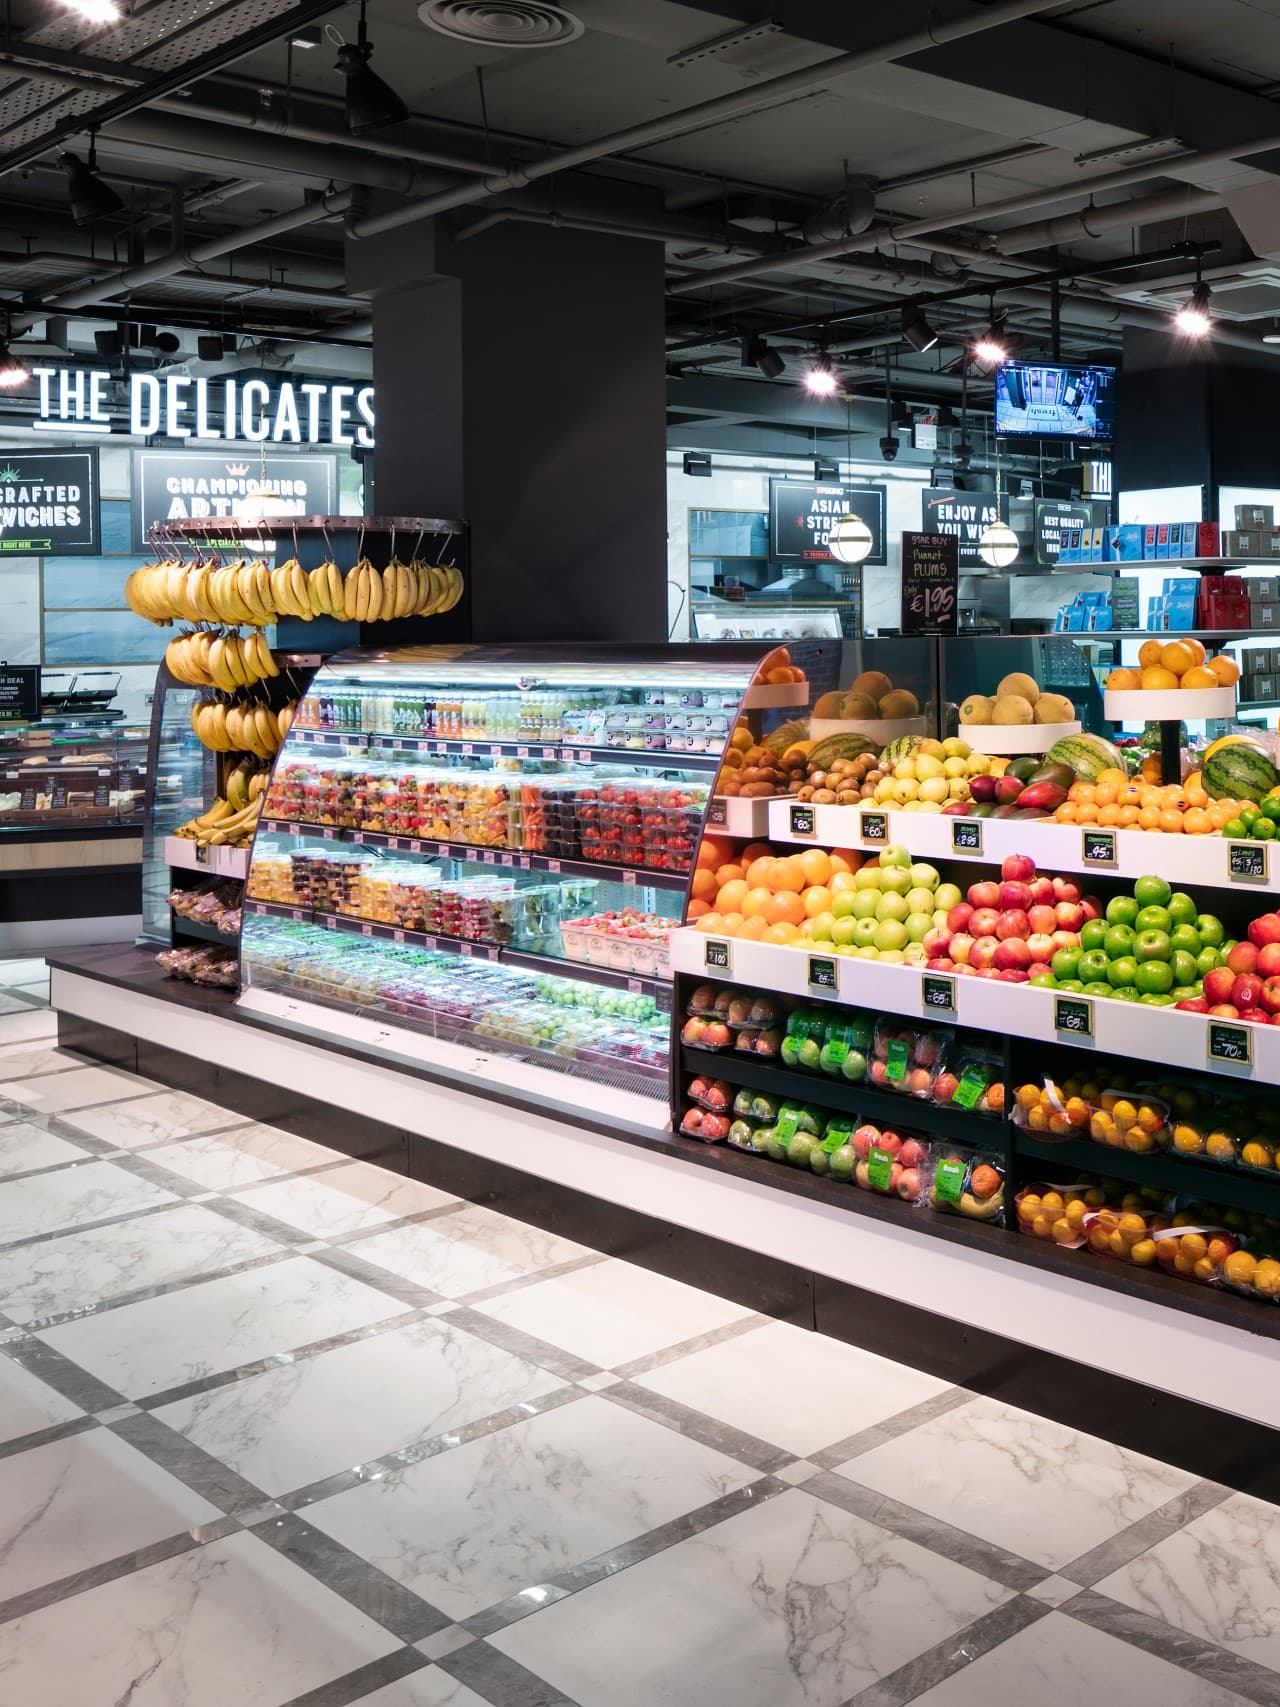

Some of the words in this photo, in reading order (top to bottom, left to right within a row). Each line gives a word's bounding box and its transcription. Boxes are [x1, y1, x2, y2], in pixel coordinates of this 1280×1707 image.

[32, 367, 112, 420] THE
[811, 499, 850, 513] ASIAN
[938, 504, 976, 520] ENJOY
[981, 506, 997, 521] AS
[1044, 516, 1059, 526] BEST
[1060, 517, 1084, 528] QUALITY
[914, 563, 947, 577] PLUMS
